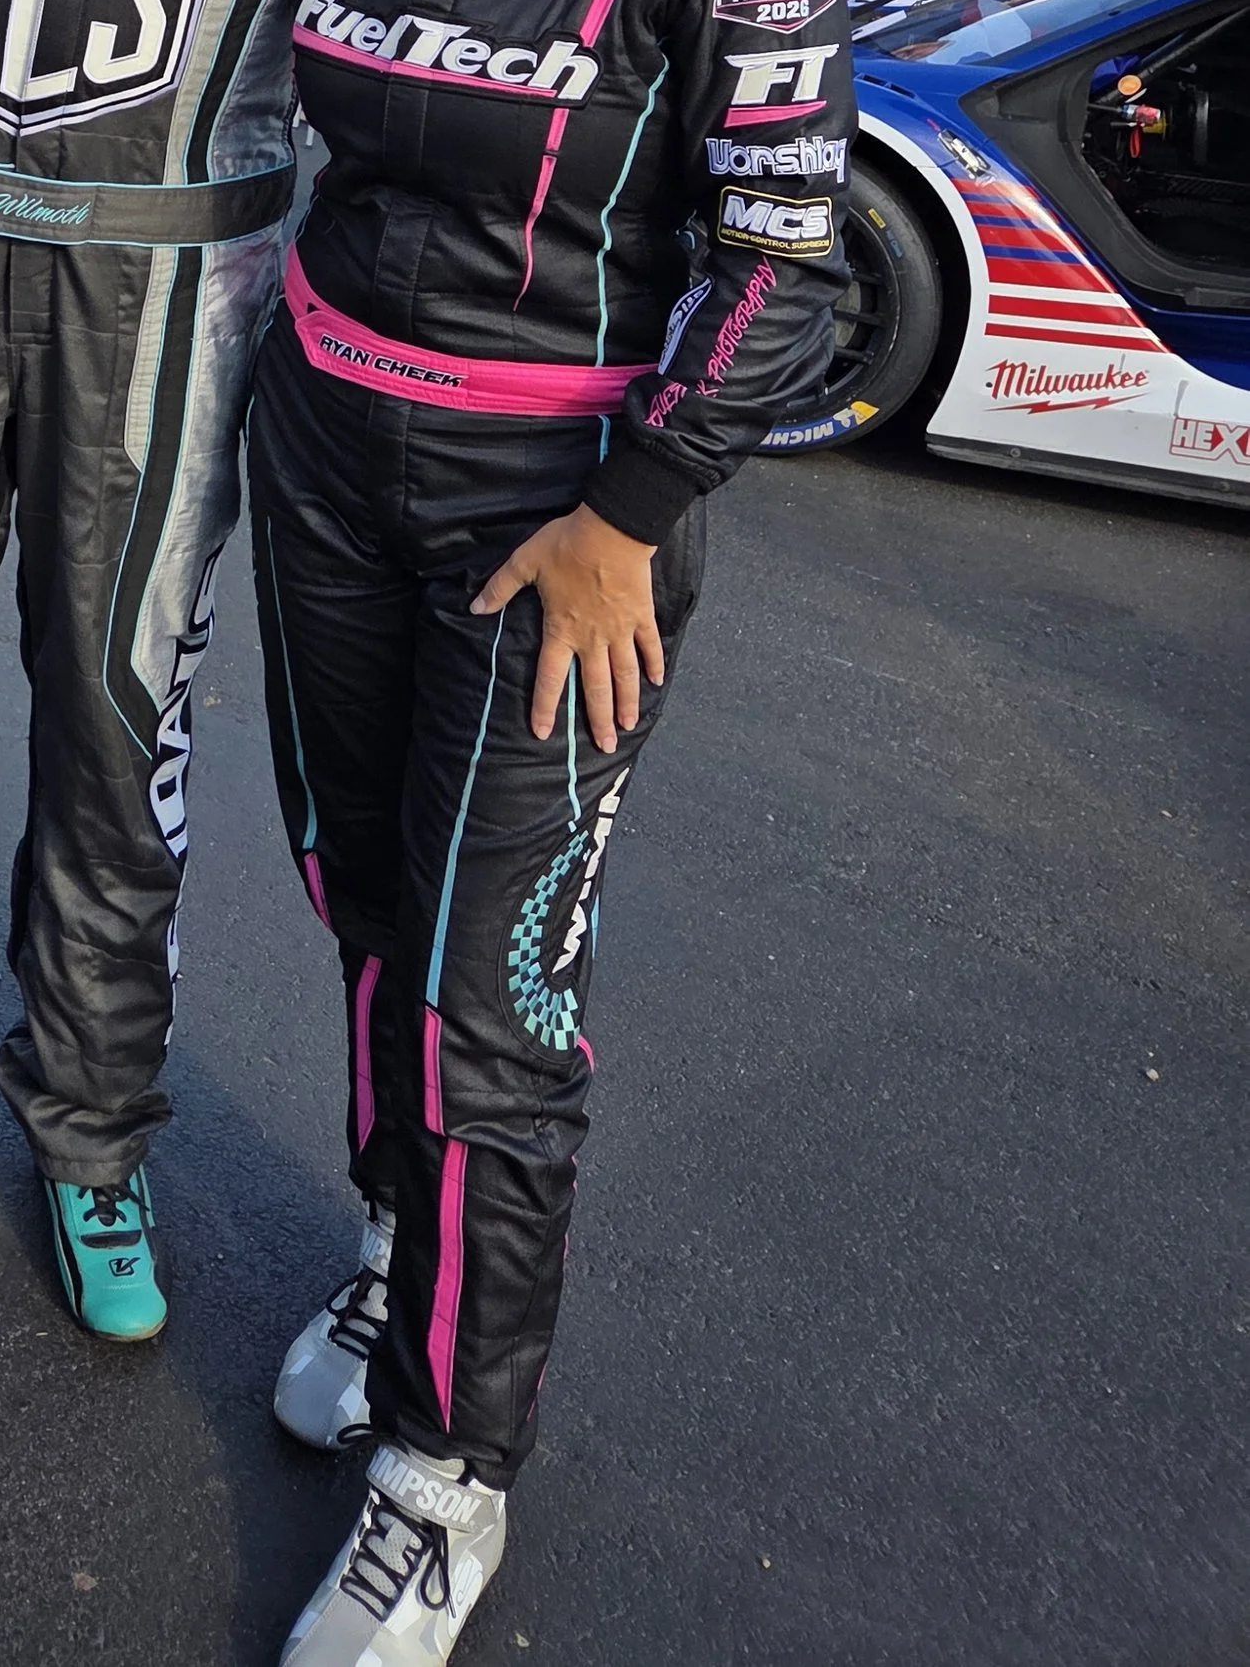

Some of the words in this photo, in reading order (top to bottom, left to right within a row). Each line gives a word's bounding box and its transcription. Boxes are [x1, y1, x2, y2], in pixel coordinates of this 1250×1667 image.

[756, 0, 810, 23] 2026
[723, 194, 829, 240] MCS
[720, 228, 749, 241] MOTION
[750, 234, 790, 250] CONTROL
[320, 333, 370, 366] RYAN
[373, 356, 468, 388] CHEEK
[984, 359, 1150, 400] Milwaukee
[1174, 418, 1250, 464] HEX
